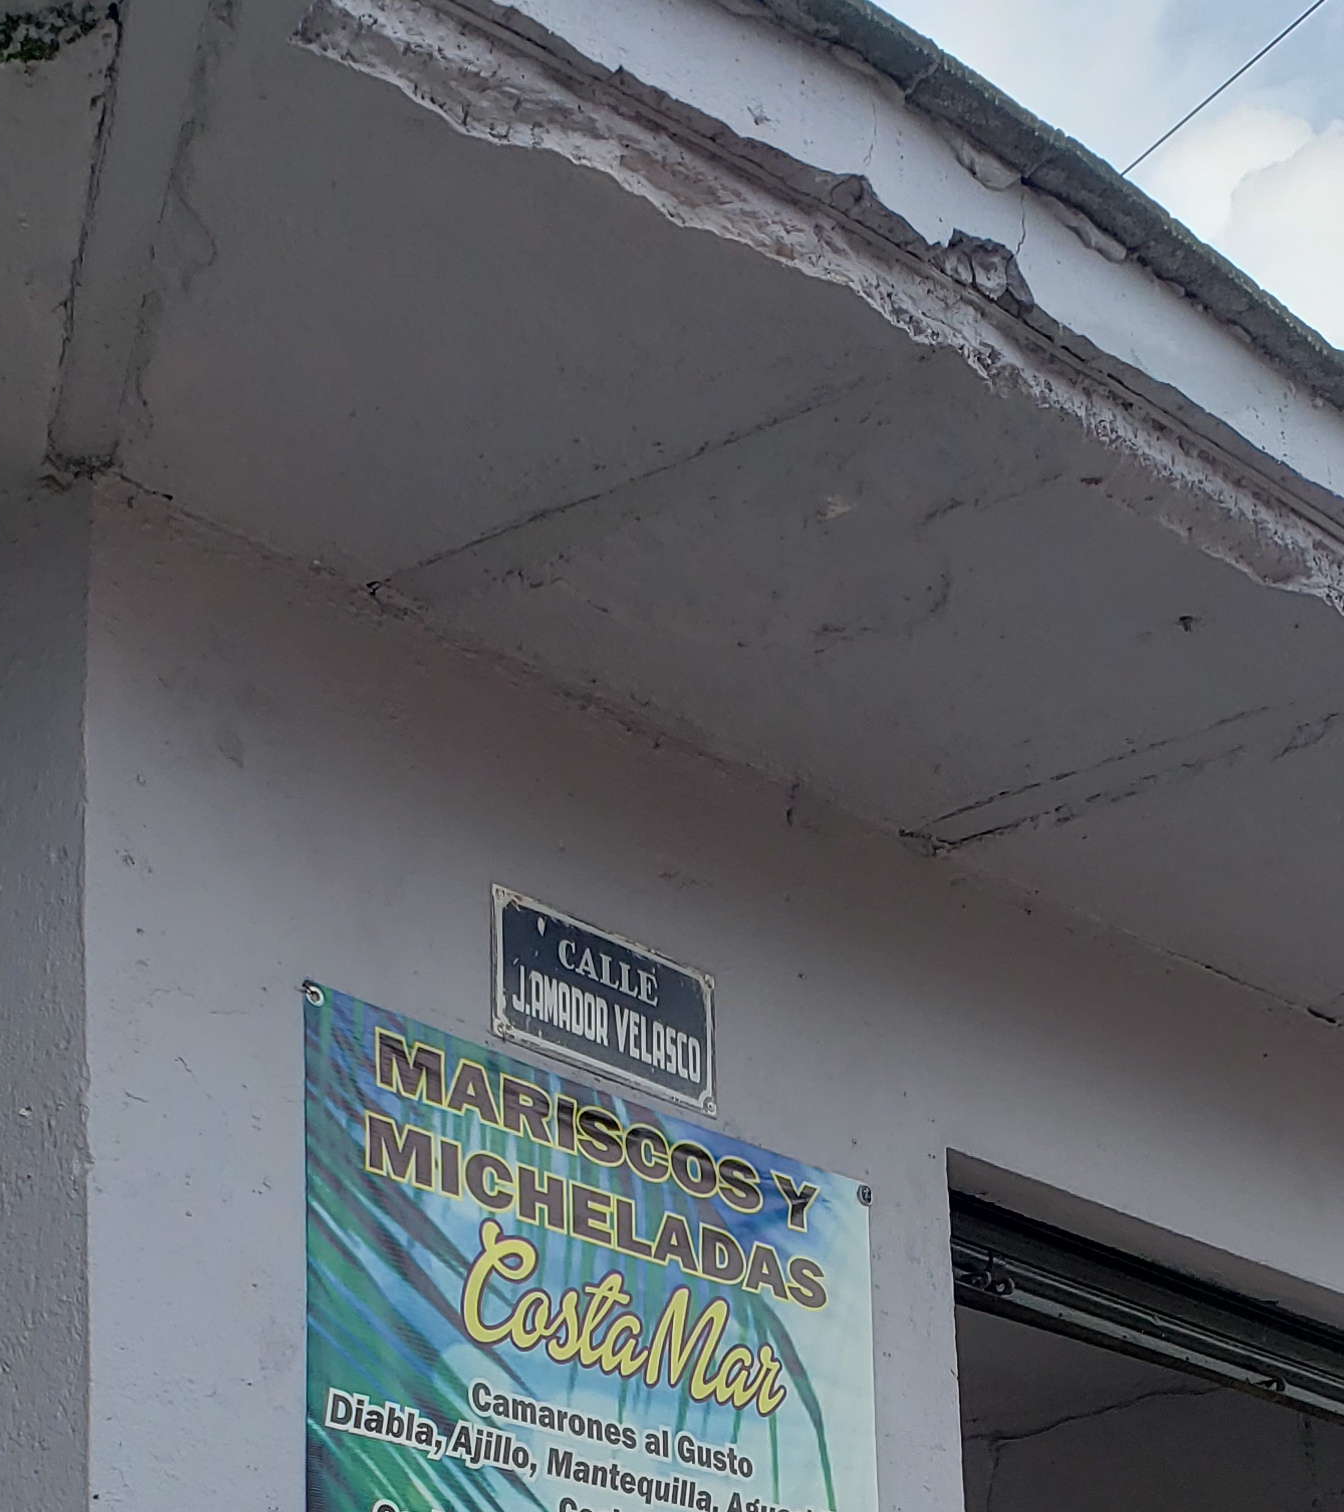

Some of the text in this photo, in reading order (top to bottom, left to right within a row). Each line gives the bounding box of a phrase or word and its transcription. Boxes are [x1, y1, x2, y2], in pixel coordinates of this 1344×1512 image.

[512, 965, 701, 1084] J.AMADOR VELASCO
[558, 939, 659, 1007] CALLE
[373, 1026, 819, 1233] MARISCOS Y
[364, 1110, 828, 1311] MICHELADAS
[329, 1390, 443, 1456] Diabla,
[453, 1424, 537, 1479] Ajillo,
[471, 1382, 754, 1479] Camarones al Gusto
